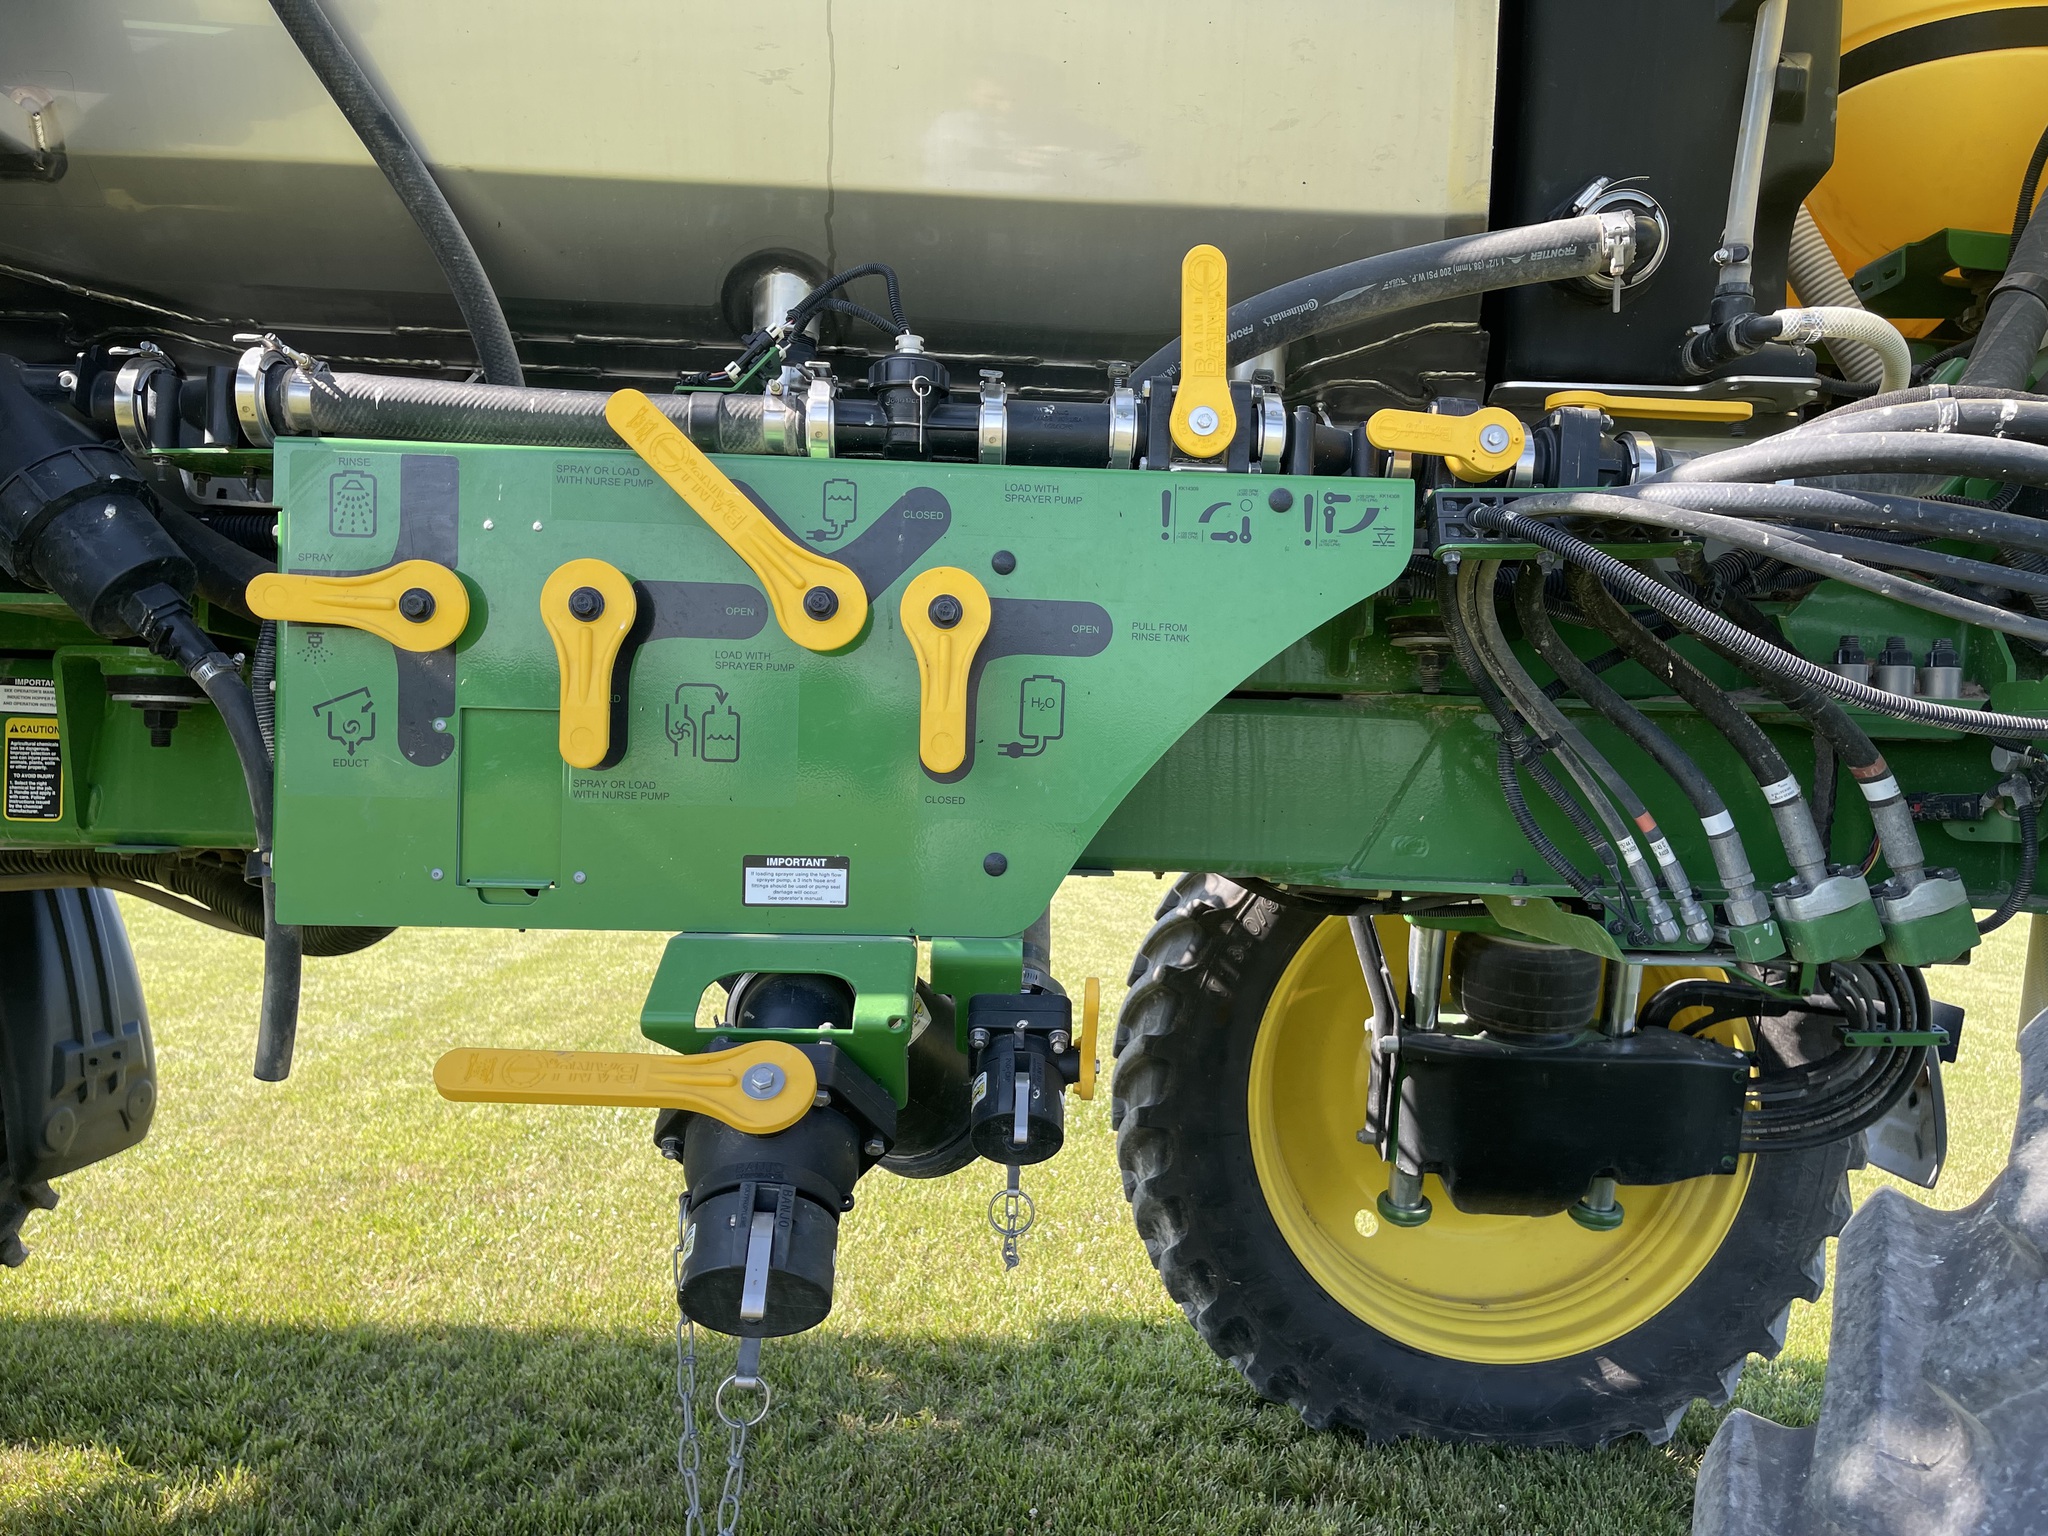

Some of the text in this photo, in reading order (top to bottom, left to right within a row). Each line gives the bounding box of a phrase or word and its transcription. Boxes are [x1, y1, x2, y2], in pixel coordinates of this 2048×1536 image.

[1530, 246, 1577, 261] FRONTIER
[1440, 267, 1452, 277] 200
[1453, 260, 1484, 274] (38.1mm)
[1427, 269, 1438, 279] PSI
[1270, 298, 1319, 321] Continental
[1226, 324, 1254, 343] FRONT
[338, 457, 371, 467] RINSE
[556, 464, 640, 476] SPRAY OR LOAD
[556, 475, 654, 488] WITH NURSE PUMP
[1004, 483, 1060, 494] LOAD WITH
[1004, 493, 1083, 505] SPRAYER PUMP
[902, 509, 944, 520] CLOSED
[297, 552, 334, 562] SPRAY
[725, 606, 755, 616] OPEN
[1071, 624, 1100, 634] OPEN
[1131, 621, 1188, 632] PULL FROM
[1131, 632, 1190, 643] RINSE TANK
[714, 650, 771, 661] LOAD WITH
[715, 660, 796, 672] SPRAYER PUMP
[14, 678, 54, 686] IMPORTAN
[20, 725, 59, 734] CAUTION
[332, 757, 369, 768] EDUCT
[573, 779, 656, 790] SPRAY OR LOAD
[572, 790, 670, 801] WITH NURSE PUMP
[924, 795, 966, 805] CLOSED
[766, 858, 827, 867] IMPORTANT
[778, 1189, 794, 1228] BANJO
